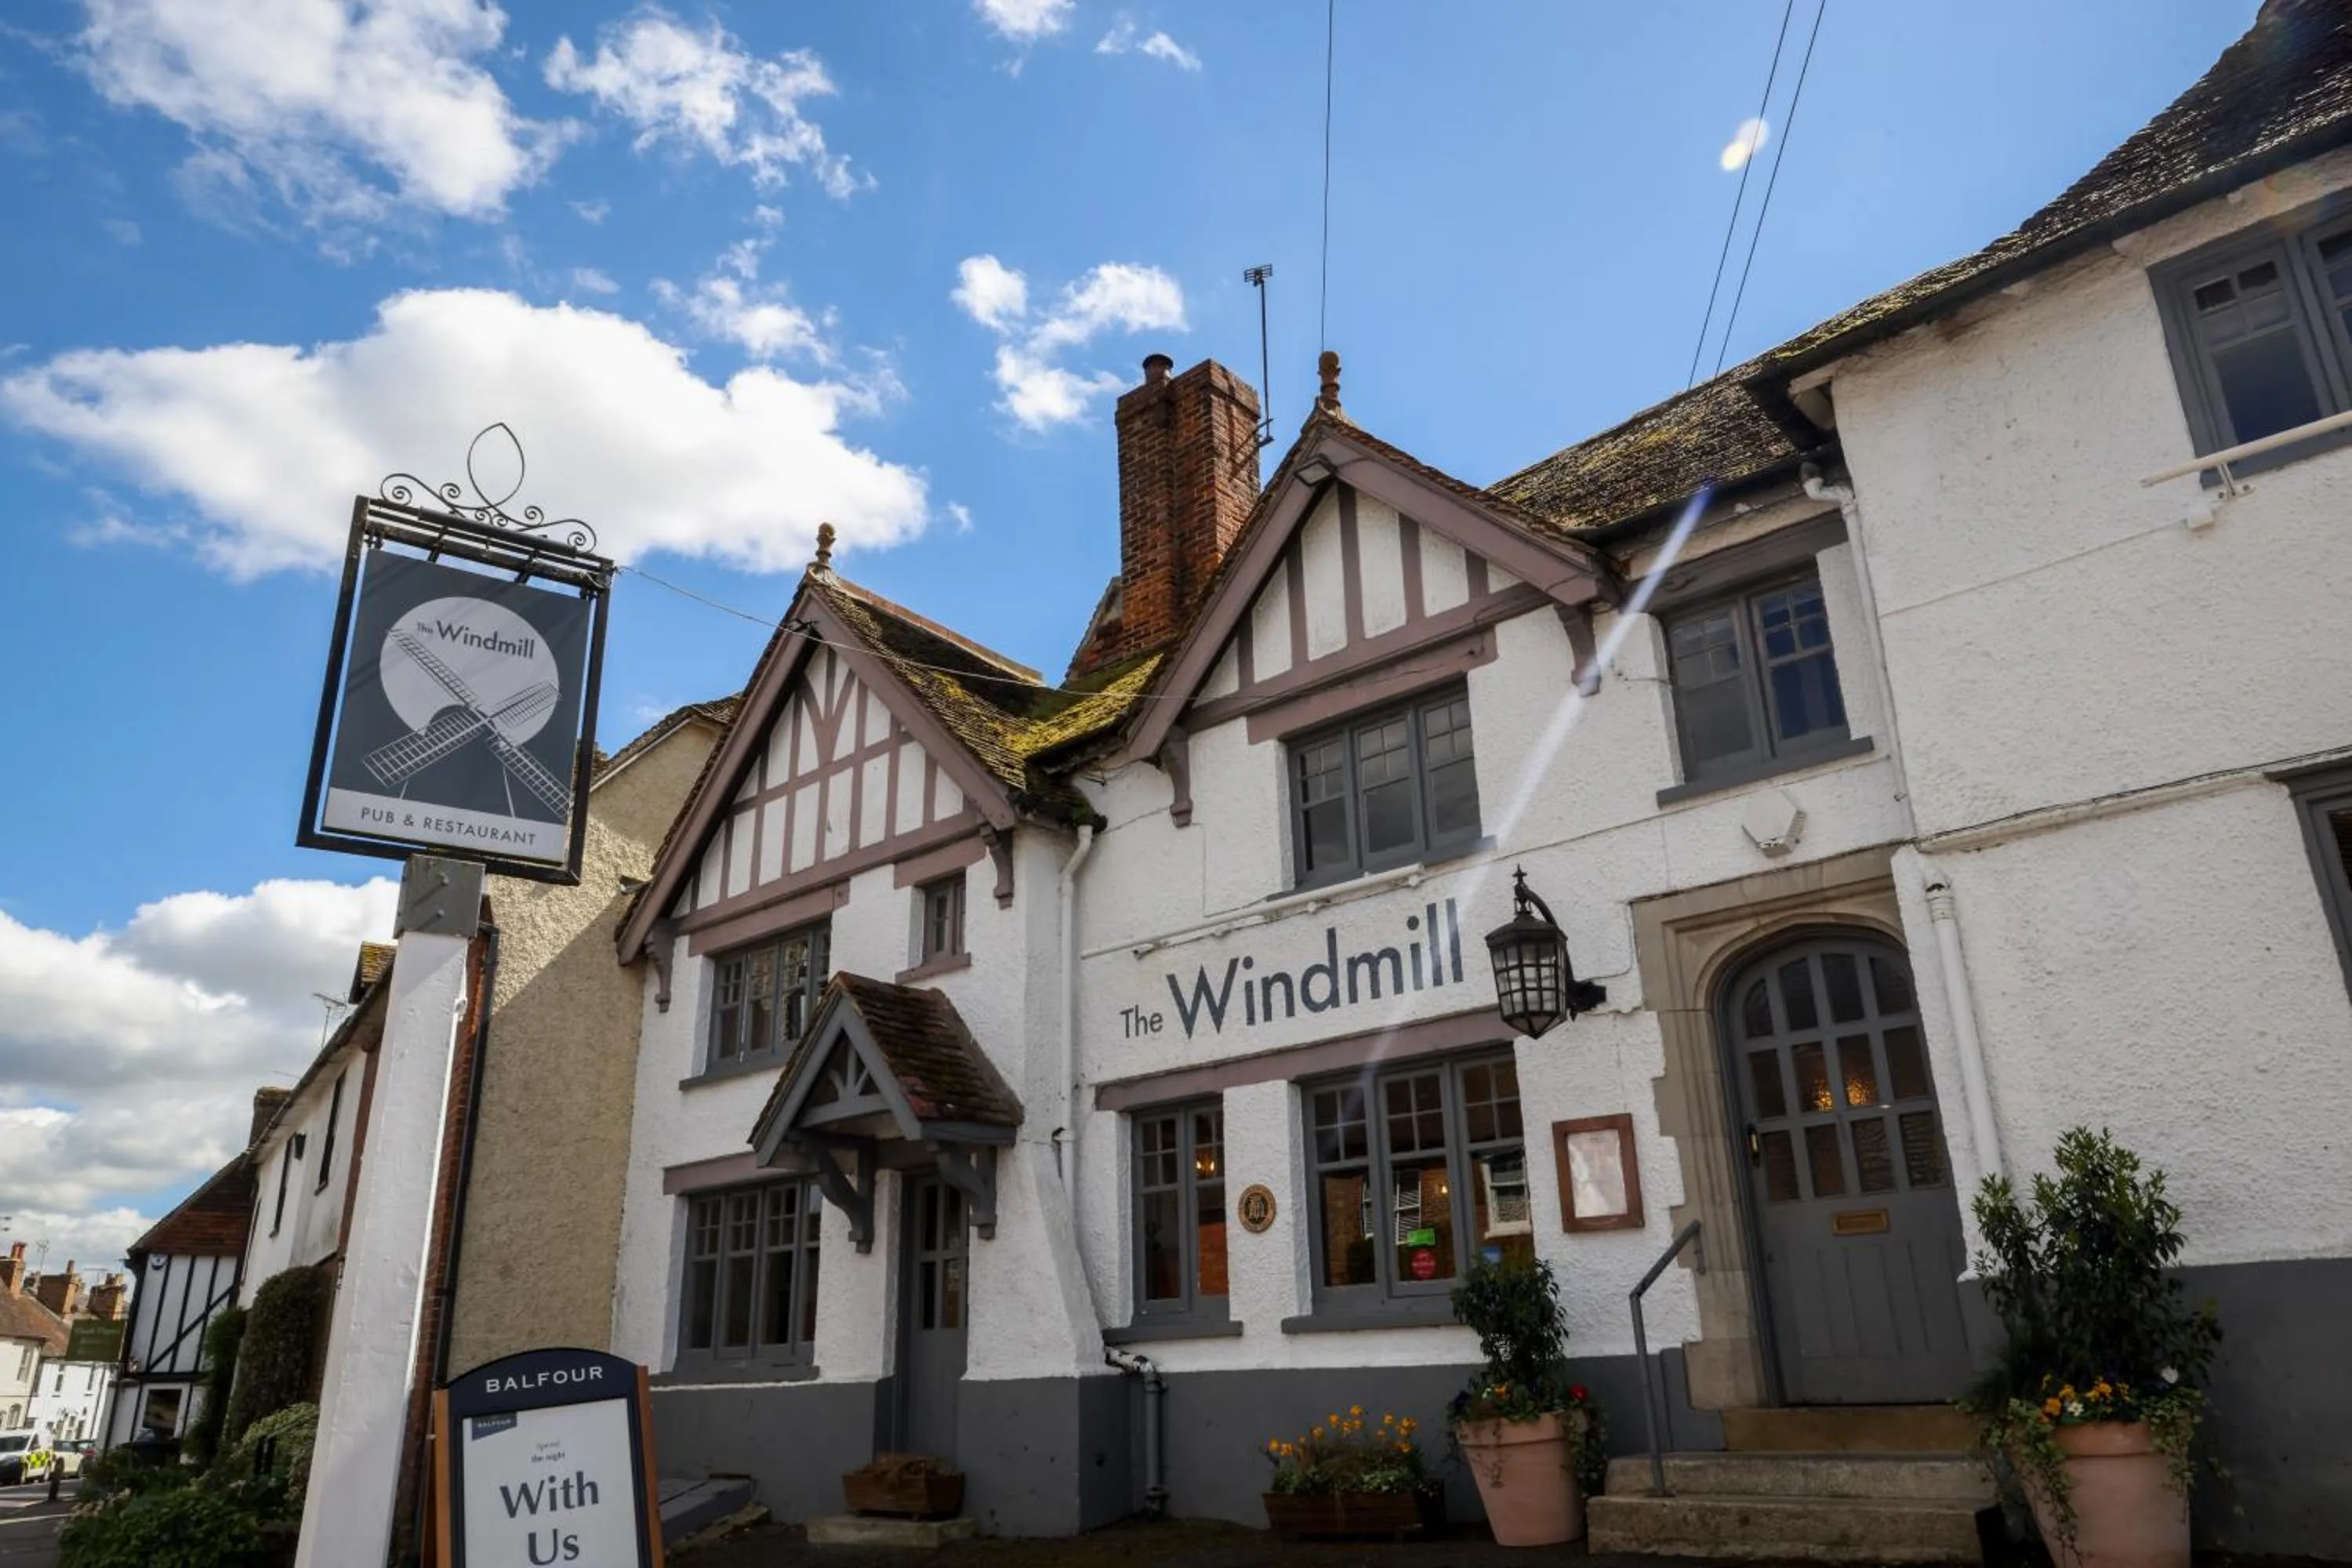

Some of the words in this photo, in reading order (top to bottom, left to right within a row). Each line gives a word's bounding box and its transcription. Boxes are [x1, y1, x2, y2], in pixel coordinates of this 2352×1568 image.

[417, 622, 434, 633] The
[436, 619, 535, 659] Windmill
[361, 807, 394, 824] PUB
[403, 814, 415, 827] &
[423, 816, 536, 845] RESTAURANT
[1120, 1004, 1164, 1039] The
[1166, 897, 1465, 1040] Windmill
[485, 1366, 604, 1393] BALFOUR
[499, 1470, 600, 1519] With
[528, 1528, 580, 1566] Us
